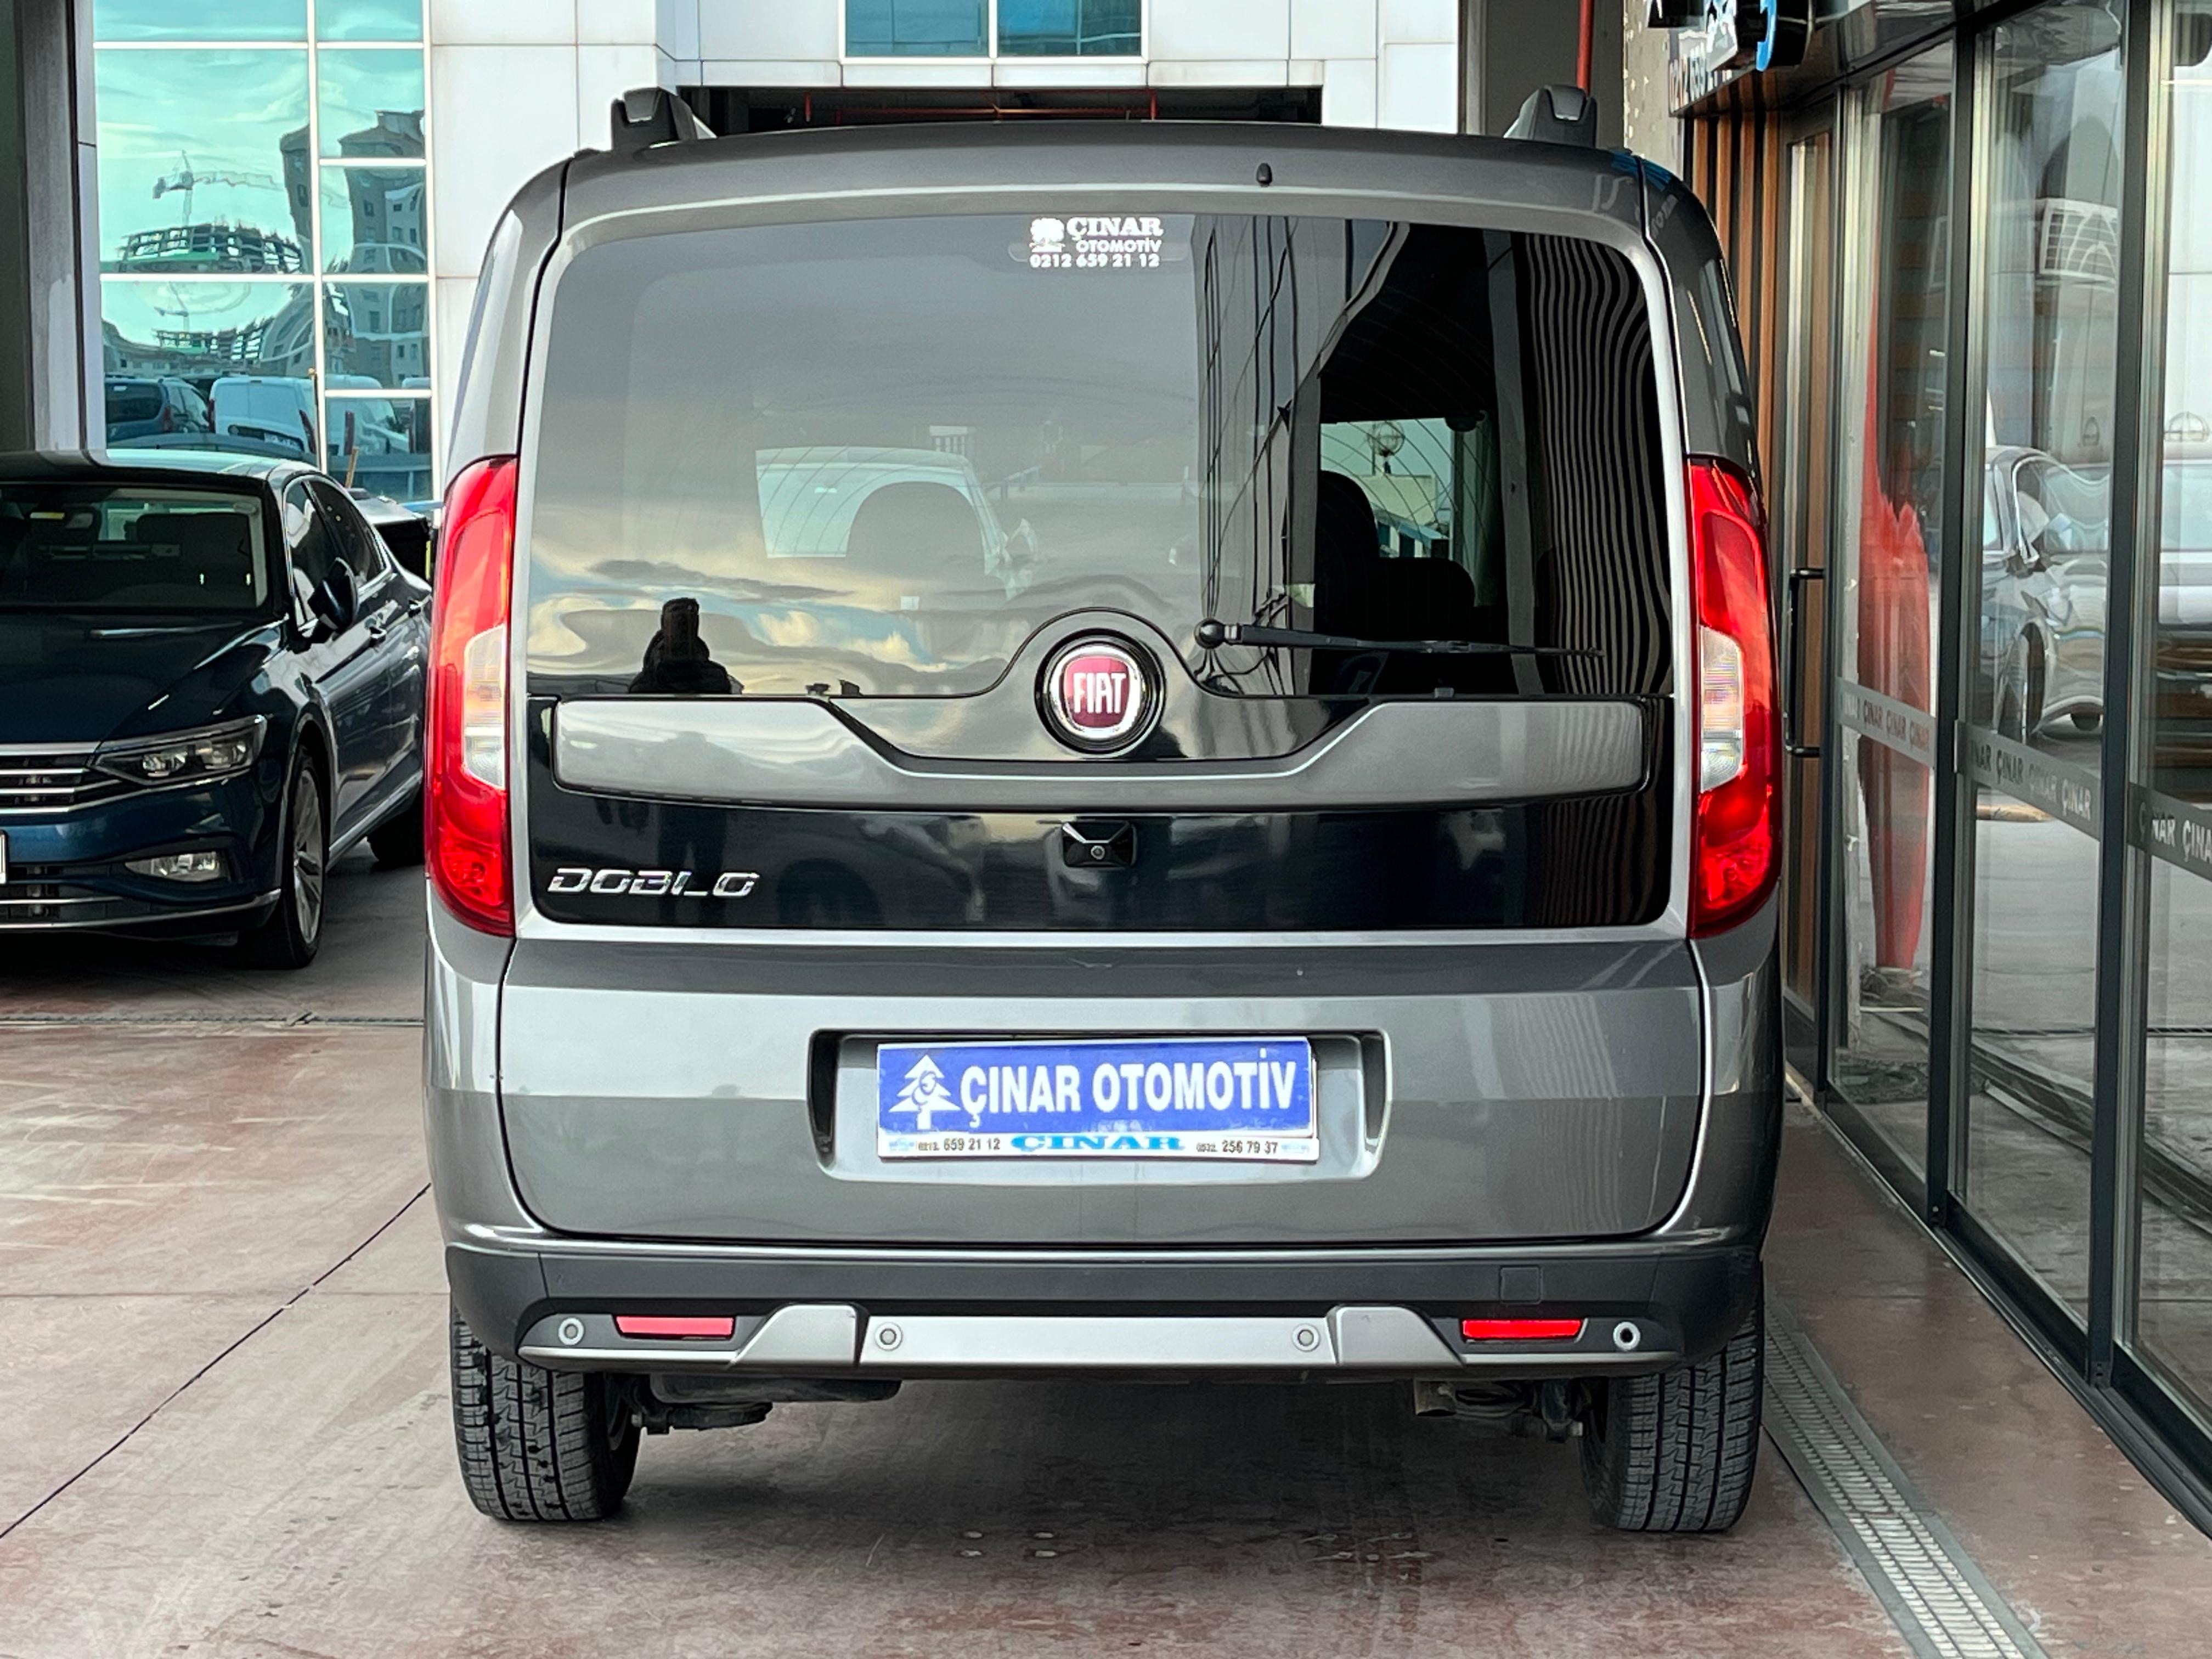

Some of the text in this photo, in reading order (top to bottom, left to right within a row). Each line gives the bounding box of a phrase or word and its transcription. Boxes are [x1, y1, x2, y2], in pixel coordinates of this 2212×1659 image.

[1066, 217, 1164, 240] ÇINAR
[1076, 237, 1161, 252] OTOMOTİV
[1030, 254, 1160, 267] 0212 659 21 12
[1073, 673, 1126, 713] FIAT
[548, 868, 760, 896] DOBLO
[961, 1065, 1081, 1128] ÇINAR
[1092, 1047, 1296, 1113] OTOMOTİV
[944, 1138, 964, 1150] 659
[968, 1138, 981, 1150] 21
[988, 1138, 1001, 1150] 12
[1222, 1139, 1243, 1154] 256
[1247, 1141, 1260, 1154] 79
[1265, 1141, 1278, 1154] 37
